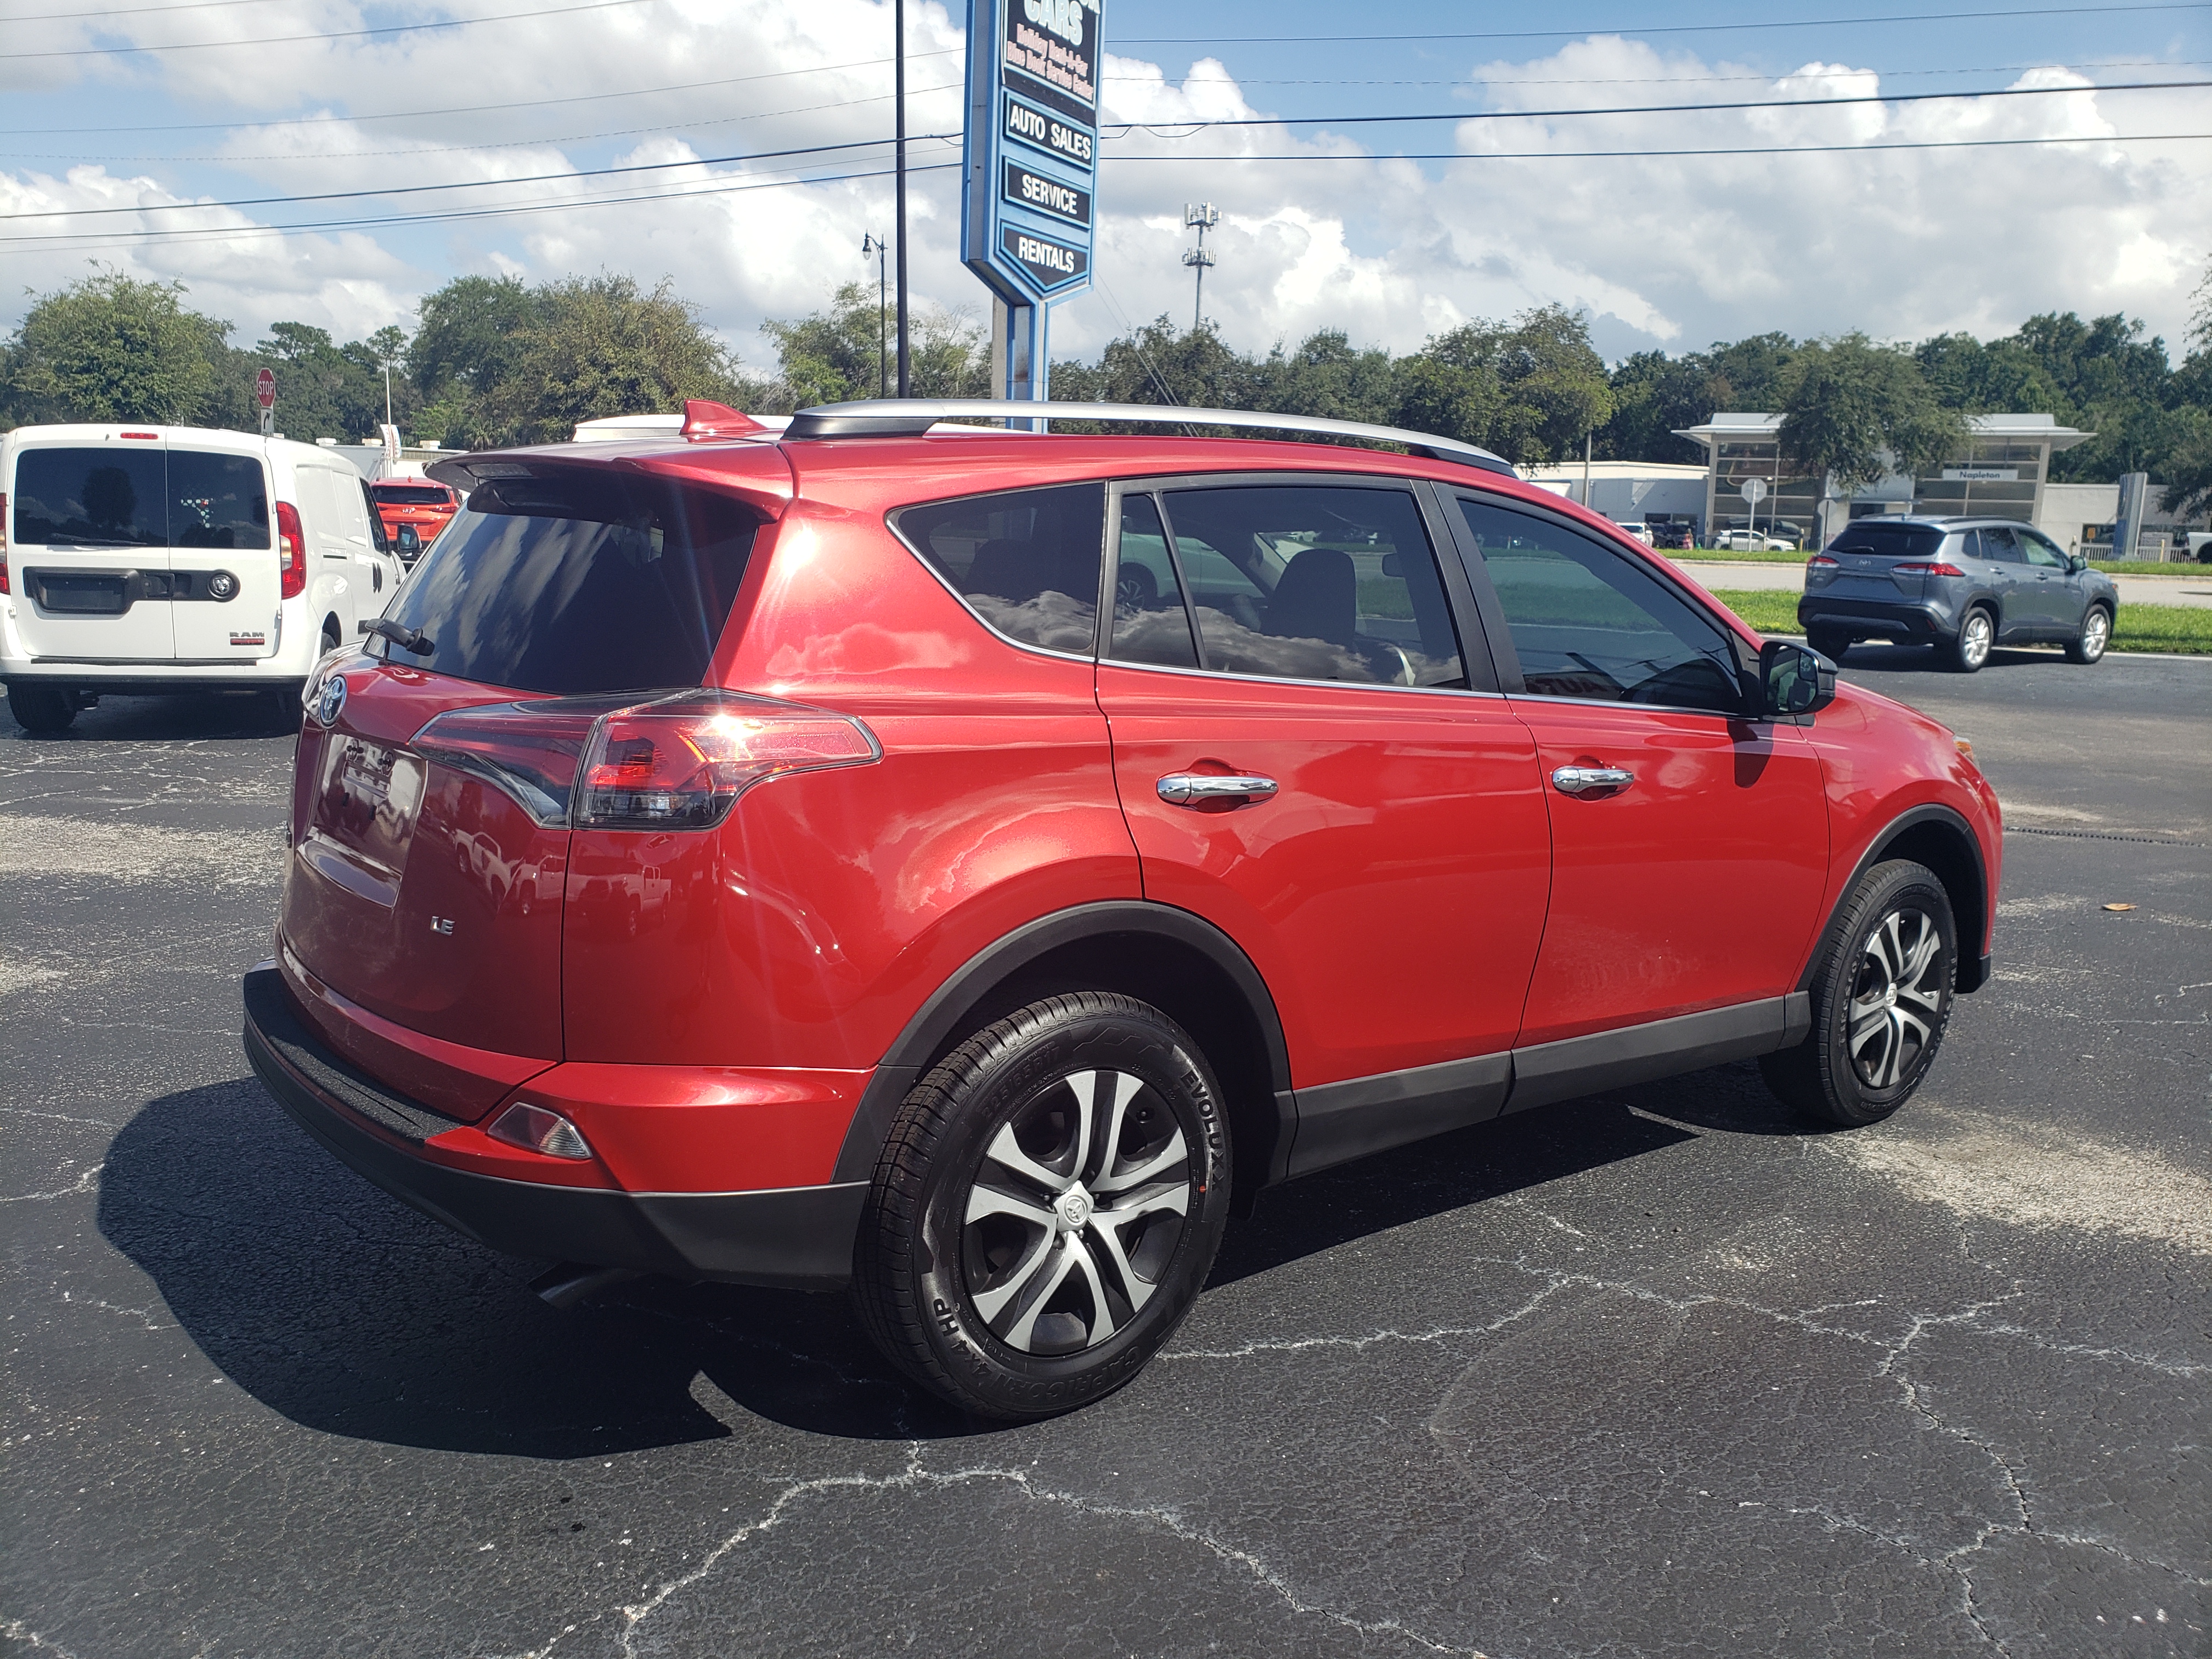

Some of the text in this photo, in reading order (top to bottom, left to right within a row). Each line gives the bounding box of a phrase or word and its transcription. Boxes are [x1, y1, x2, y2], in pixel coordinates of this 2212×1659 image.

[1024, 0, 1083, 45] CARS
[1009, 105, 1091, 160] AUTO SALES
[1022, 173, 1077, 215] SERVICE
[1019, 236, 1074, 273] RENTALS
[258, 381, 274, 395] STOP
[1960, 471, 2000, 479] Napleton
[430, 916, 455, 936] LE
[1181, 1070, 1224, 1192] EVOLUXX
[933, 1297, 960, 1337] HP
